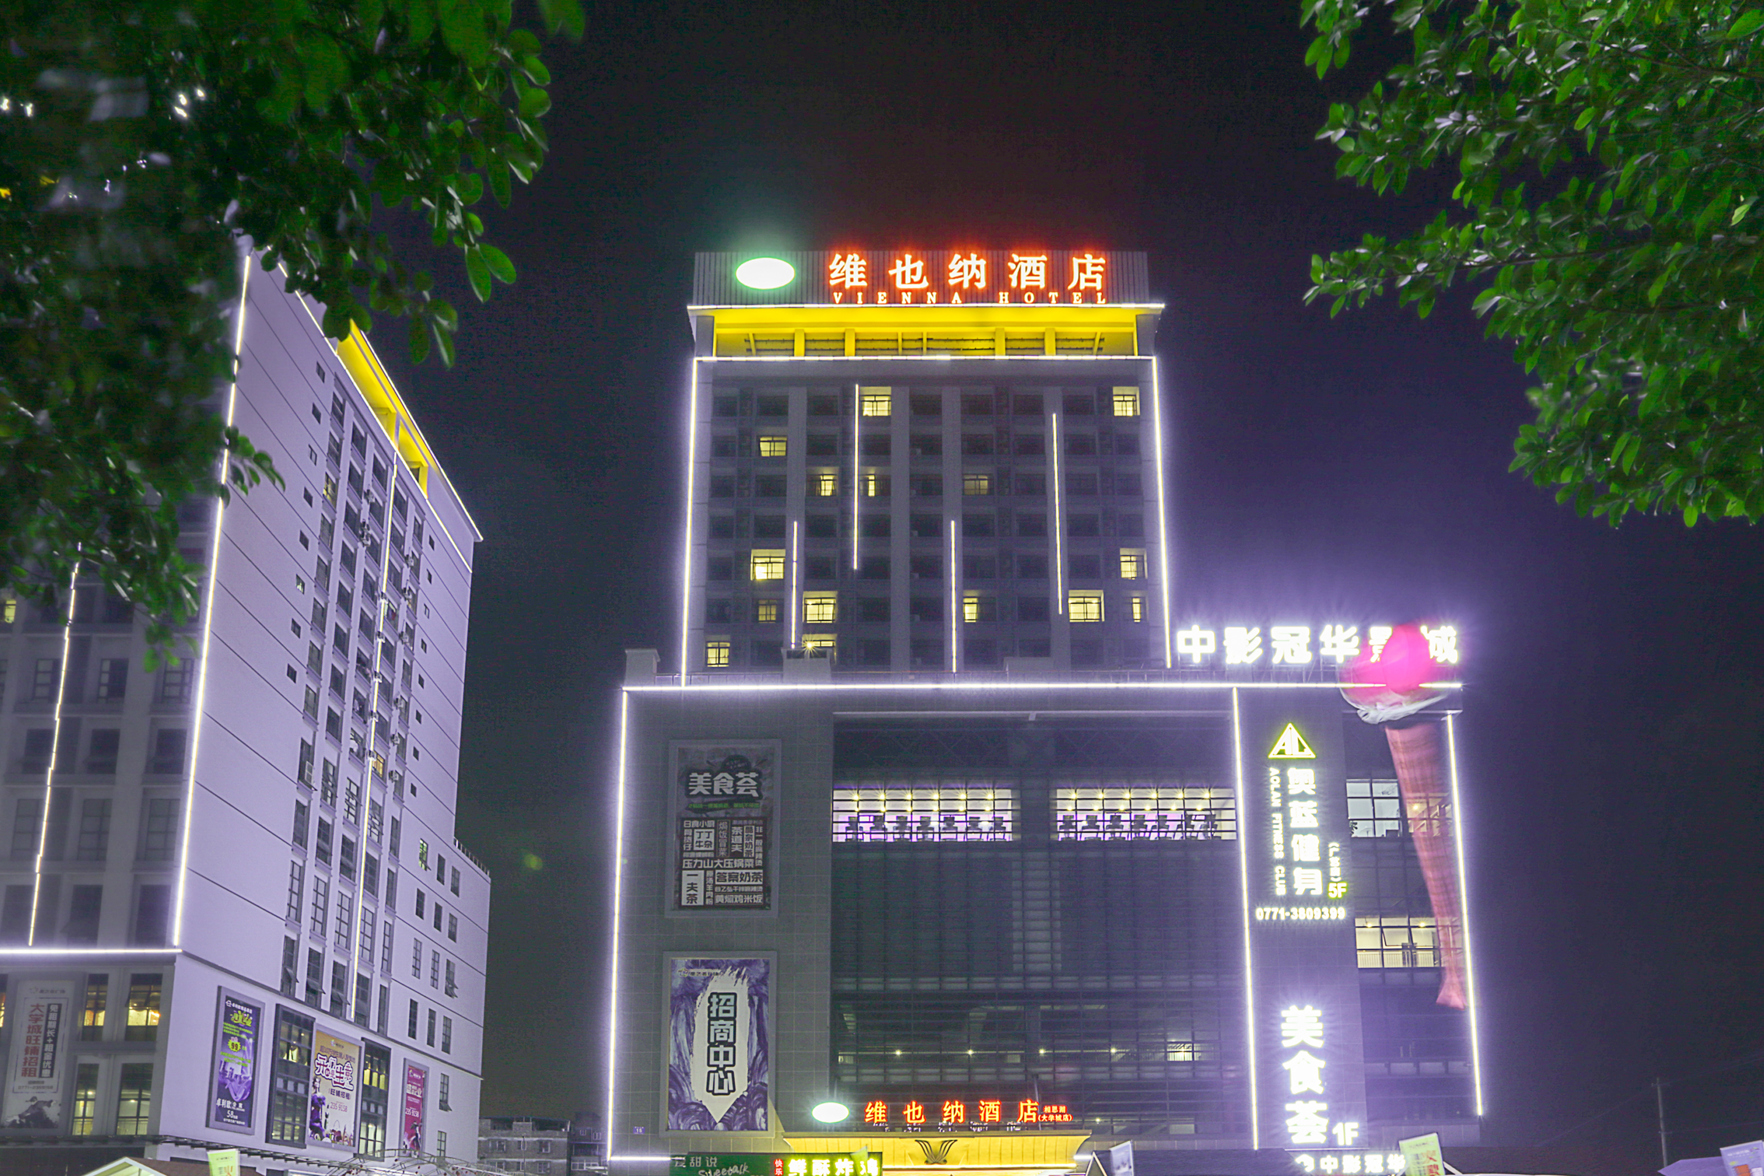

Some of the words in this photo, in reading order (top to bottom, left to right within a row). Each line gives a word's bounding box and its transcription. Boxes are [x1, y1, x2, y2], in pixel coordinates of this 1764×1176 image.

[829, 253, 1106, 291] 维也纳酒店
[832, 292, 962, 304] VIENNA
[999, 292, 1106, 304] HOTEL
[688, 771, 759, 797] 美食荟
[1269, 767, 1282, 807] AOLAN
[1274, 865, 1287, 896] CLUB
[1328, 882, 1348, 898] 5F
[21, 1003, 45, 1077] 大学城旺铺招租
[707, 993, 737, 1095] 招商中心
[1280, 1004, 1329, 1144] 美食荟
[864, 1099, 1039, 1124] 维也纳酒店
[1332, 1121, 1359, 1146] 1F
[774, 1159, 783, 1175] 快乐
